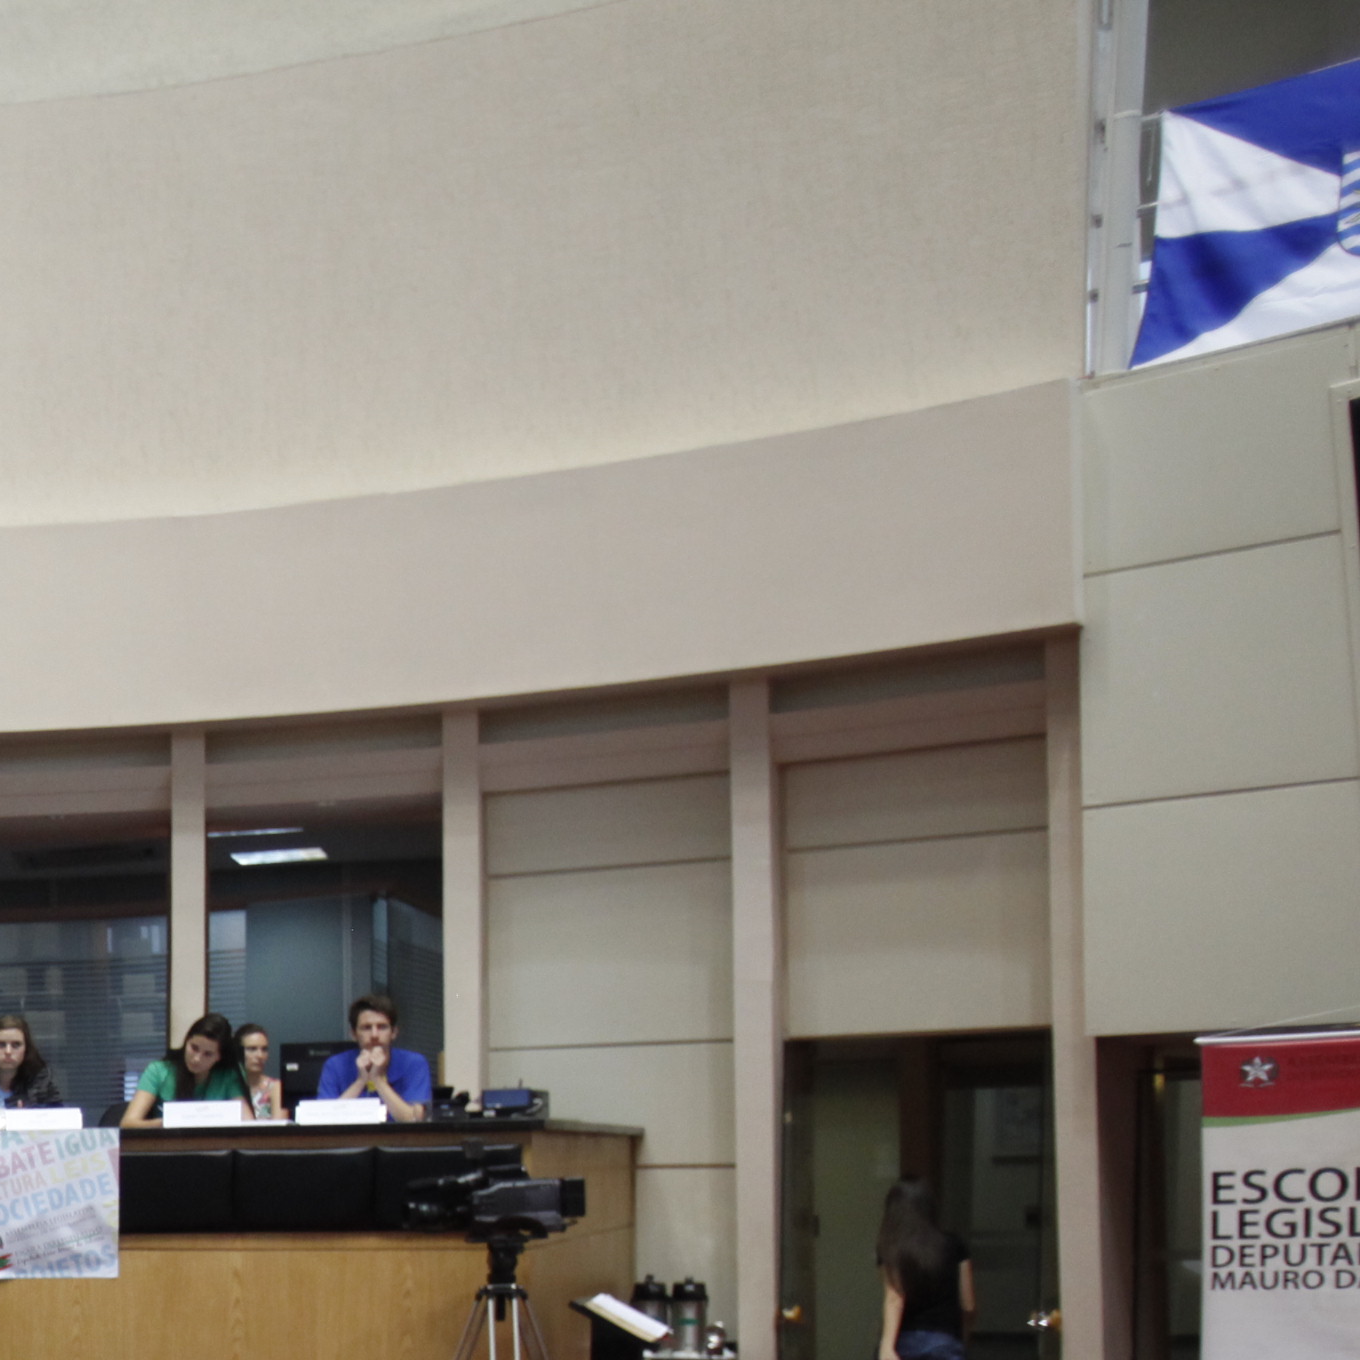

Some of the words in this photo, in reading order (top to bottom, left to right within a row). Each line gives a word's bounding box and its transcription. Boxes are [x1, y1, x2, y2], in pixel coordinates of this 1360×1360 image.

[49, 1152, 109, 1184] LEIS
[1211, 1243, 1360, 1268] DEPUTA
[1211, 1270, 1324, 1290] MAURO
